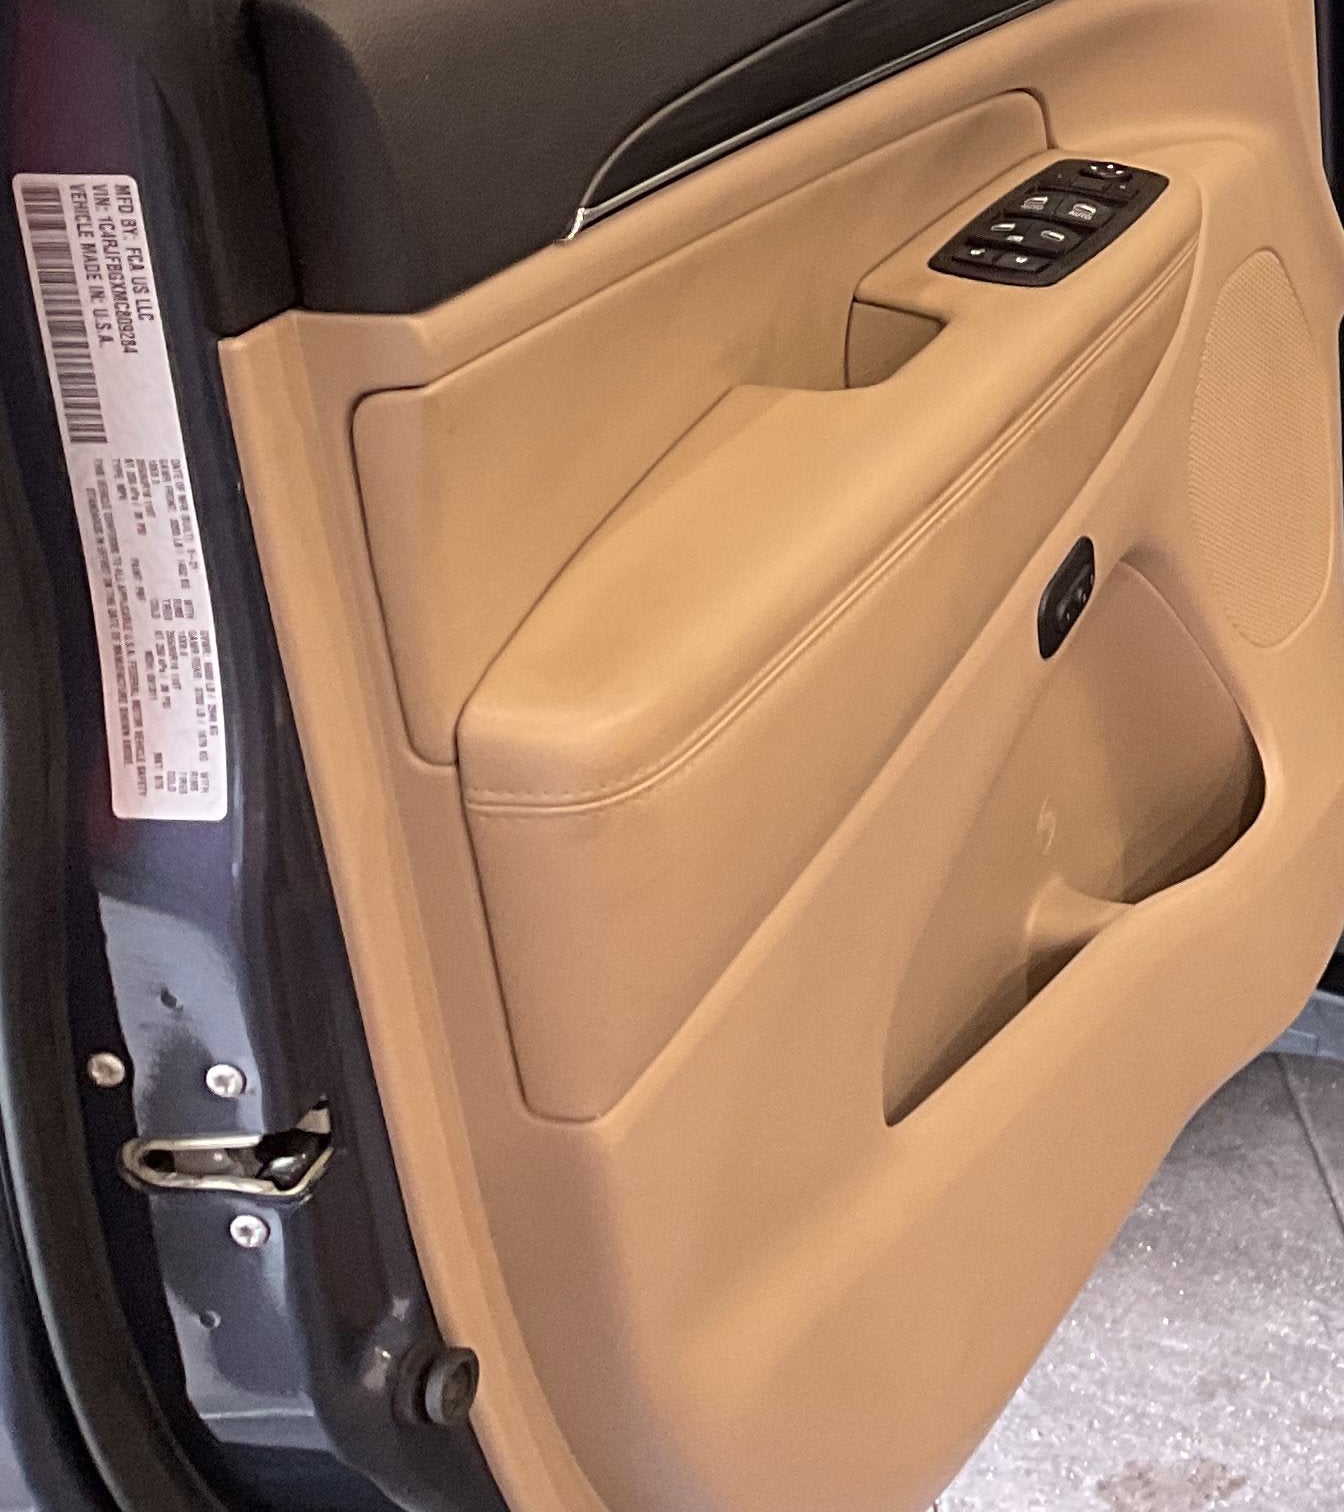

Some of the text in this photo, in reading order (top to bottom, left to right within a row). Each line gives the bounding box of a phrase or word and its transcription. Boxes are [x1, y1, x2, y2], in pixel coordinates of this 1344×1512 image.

[70, 183, 93, 239] VEHICLE
[92, 184, 110, 212] VIN:
[80, 243, 101, 281] MADE
[115, 184, 155, 322] MFD BY: FCA US LLC
[89, 285, 106, 303] IN:
